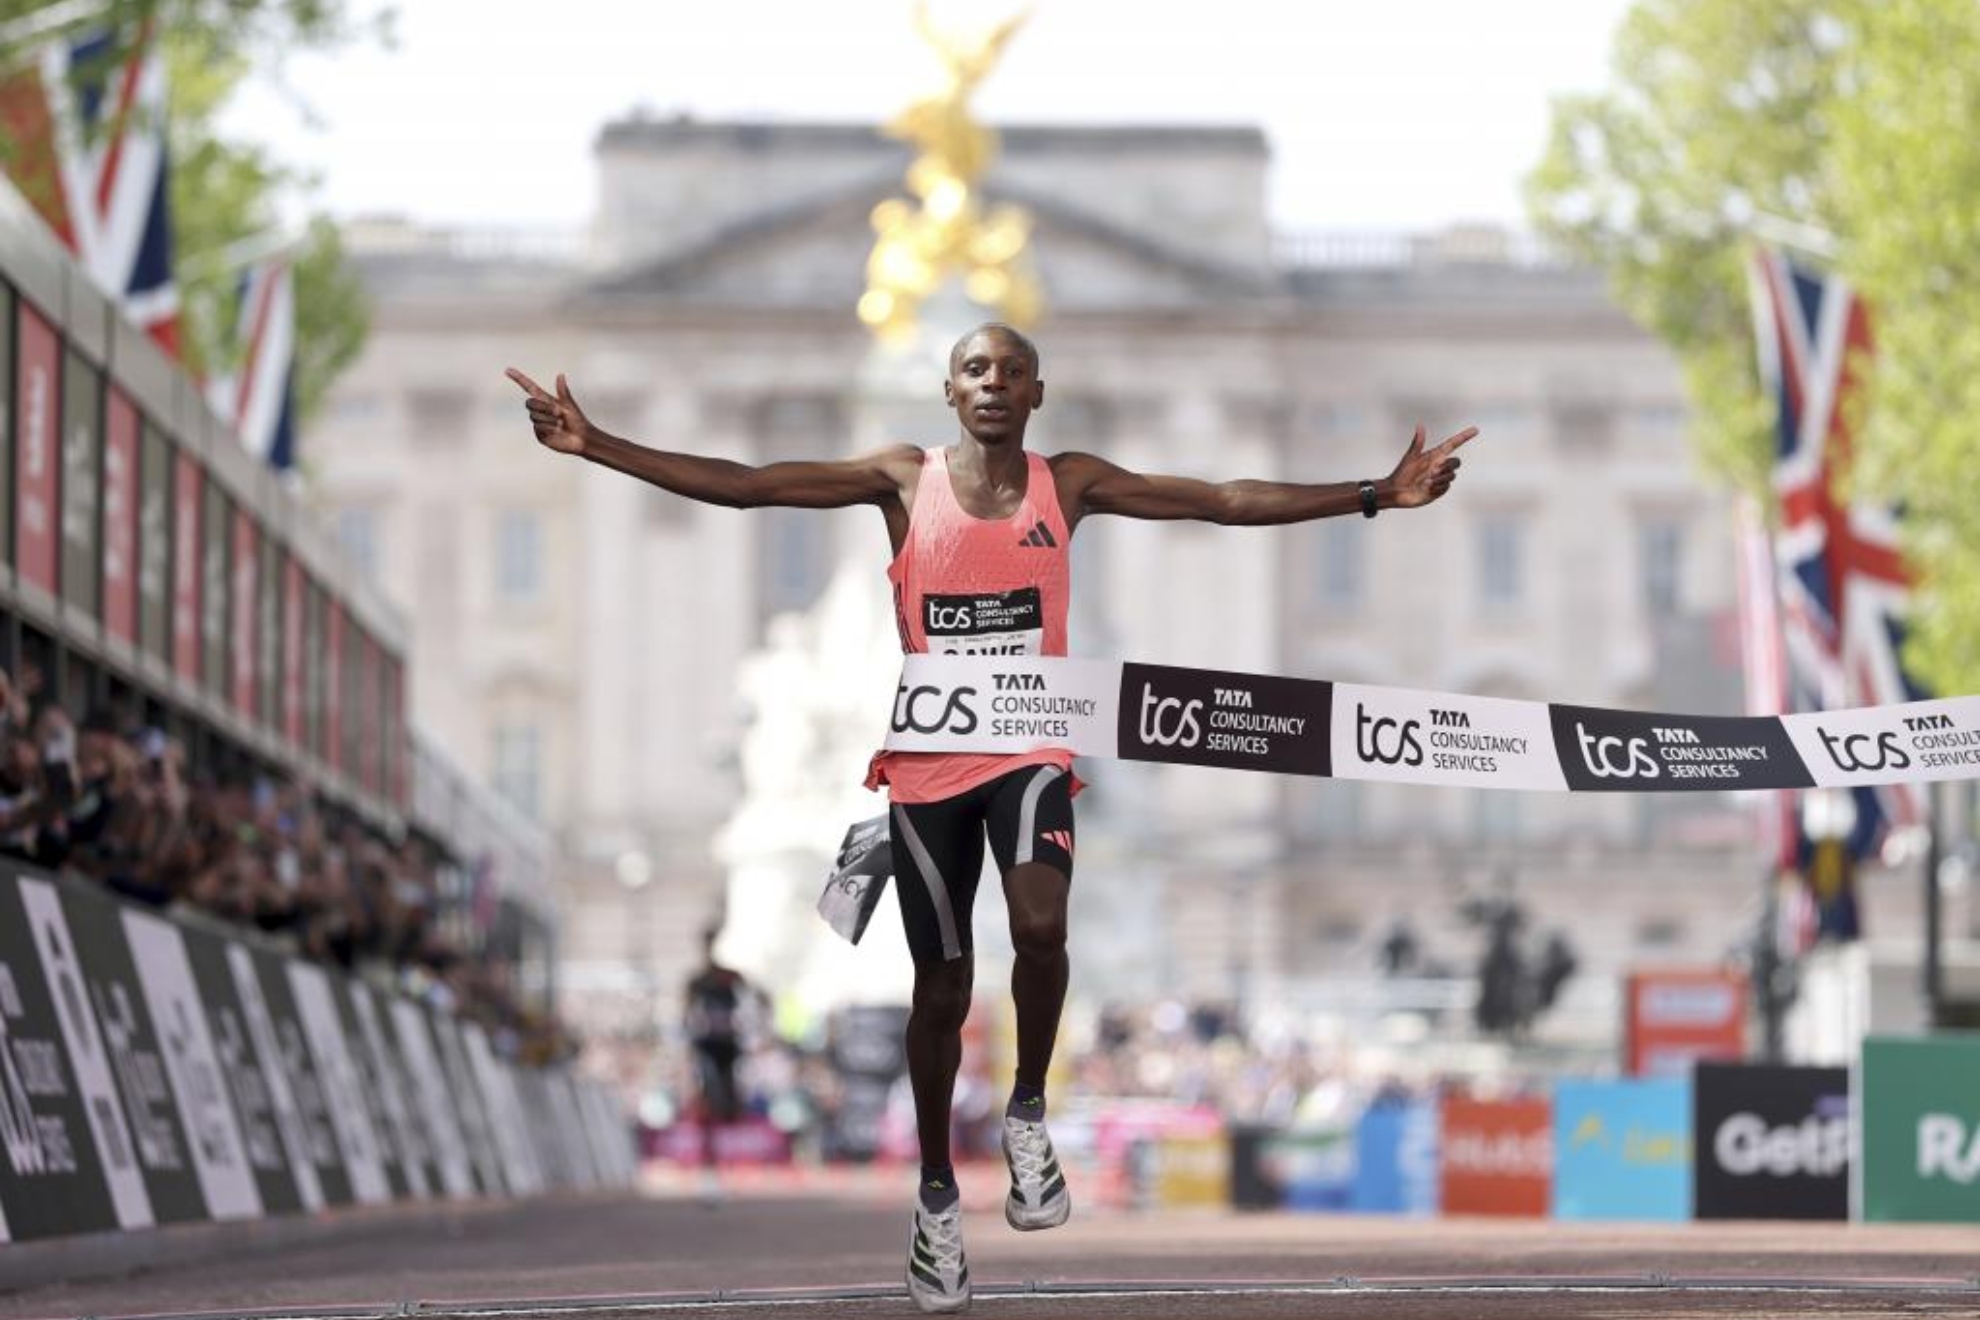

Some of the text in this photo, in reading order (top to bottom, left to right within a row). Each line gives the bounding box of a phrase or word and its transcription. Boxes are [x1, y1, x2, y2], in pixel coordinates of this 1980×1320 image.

[974, 600, 1002, 608] TATA
[975, 604, 1034, 618] CONSULTANCY
[929, 601, 971, 629] tcs
[976, 616, 1014, 628] SERVICES
[991, 674, 1046, 691] TATA
[891, 674, 978, 735] tcs
[991, 696, 1096, 717] CONSULTANCY
[1213, 688, 1253, 708] TATA
[1139, 682, 1203, 748] tcs
[1209, 711, 1306, 735] CONSULTANCY
[1429, 709, 1471, 728] TATA
[1902, 714, 1954, 731] TATA
[991, 719, 1068, 737] SERVICES
[1357, 703, 1423, 766] tcs
[1651, 728, 1700, 743] TATA
[1206, 733, 1269, 754] SERVICES
[1430, 731, 1528, 754] CONSULTANCY
[1576, 722, 1660, 778] tcs
[1817, 726, 1911, 772] tcs
[1432, 753, 1497, 772] SERVICES
[1660, 746, 1768, 761] CONSULTANCY
[1668, 764, 1740, 778] SERVICES
